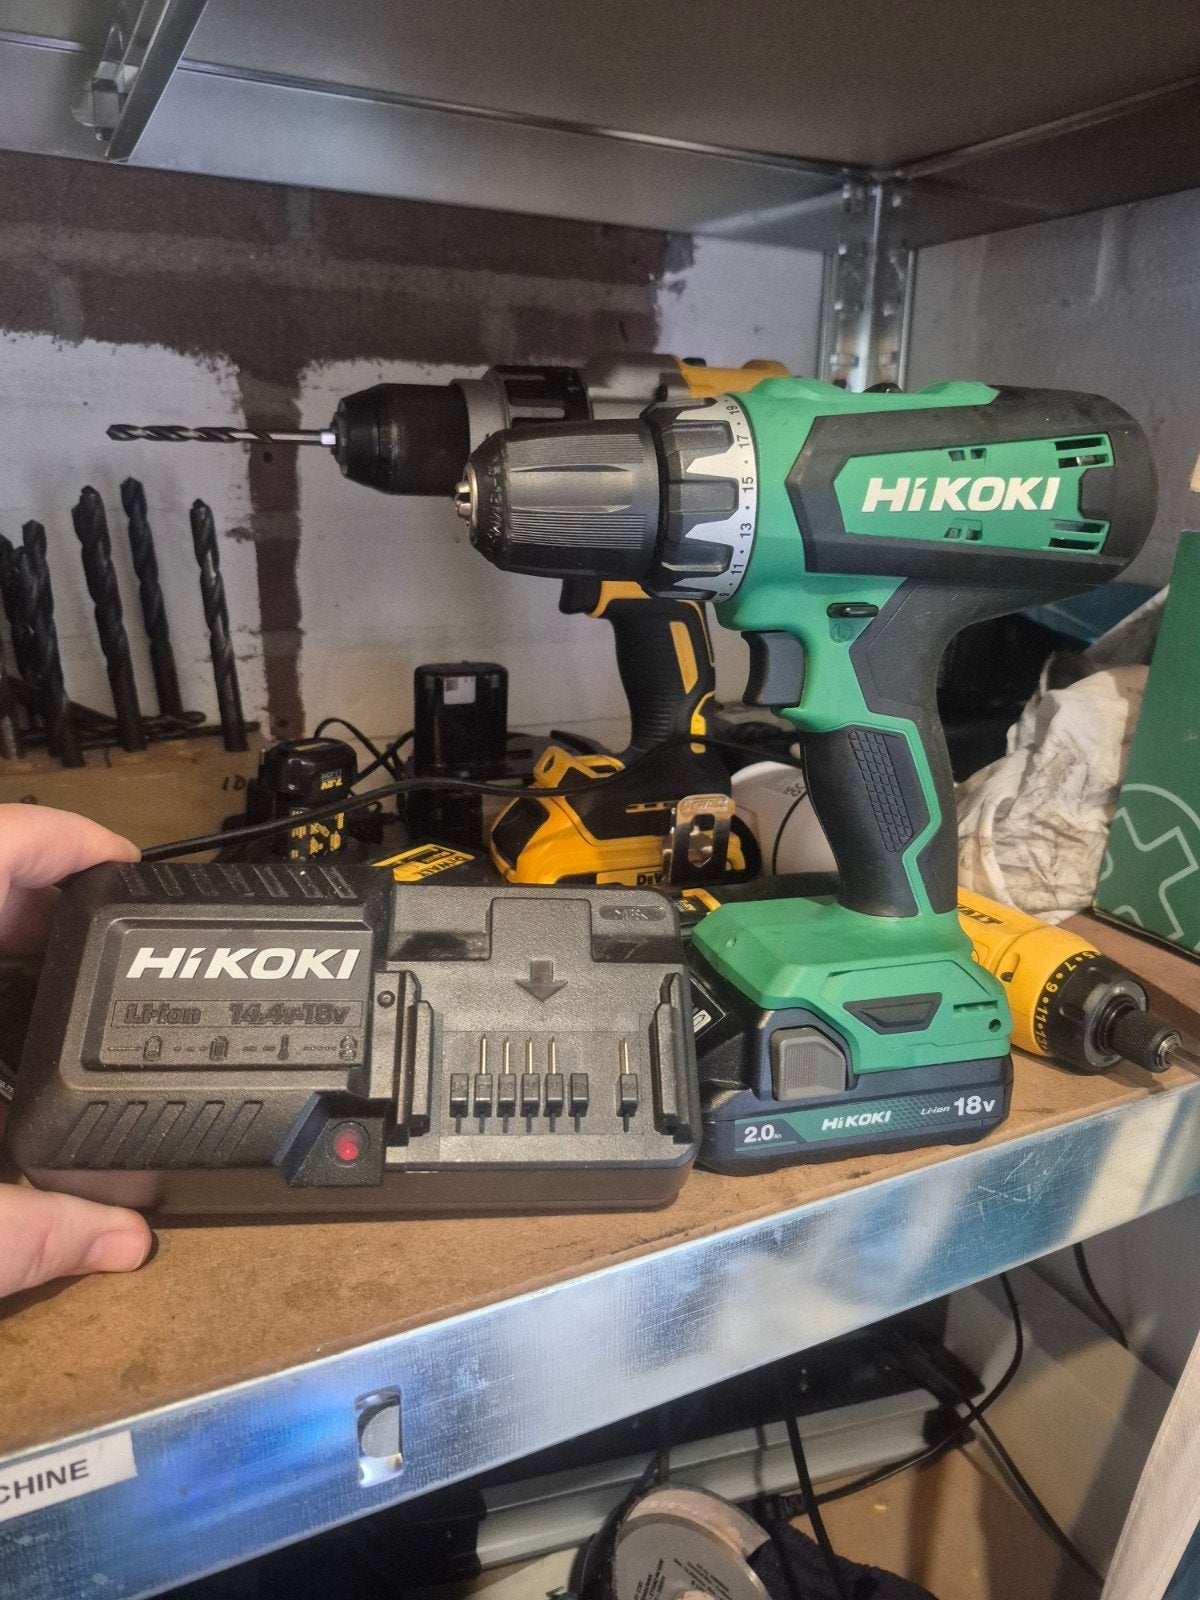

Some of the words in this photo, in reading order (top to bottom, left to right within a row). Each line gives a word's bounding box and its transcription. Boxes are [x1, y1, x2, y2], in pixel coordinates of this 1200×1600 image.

[725, 404, 741, 416] 19
[737, 434, 750, 449] 17
[742, 476, 754, 493] 15
[861, 477, 1061, 513] HiKOKI
[740, 522, 752, 538] 13
[731, 563, 745, 575] 11
[126, 947, 360, 980] HiKOKI
[1065, 961, 1077, 972] 7
[1045, 981, 1059, 993] 9
[1035, 1006, 1049, 1022] 11
[821, 1111, 892, 1131] HiKOKI
[921, 1105, 951, 1116] Li-ion
